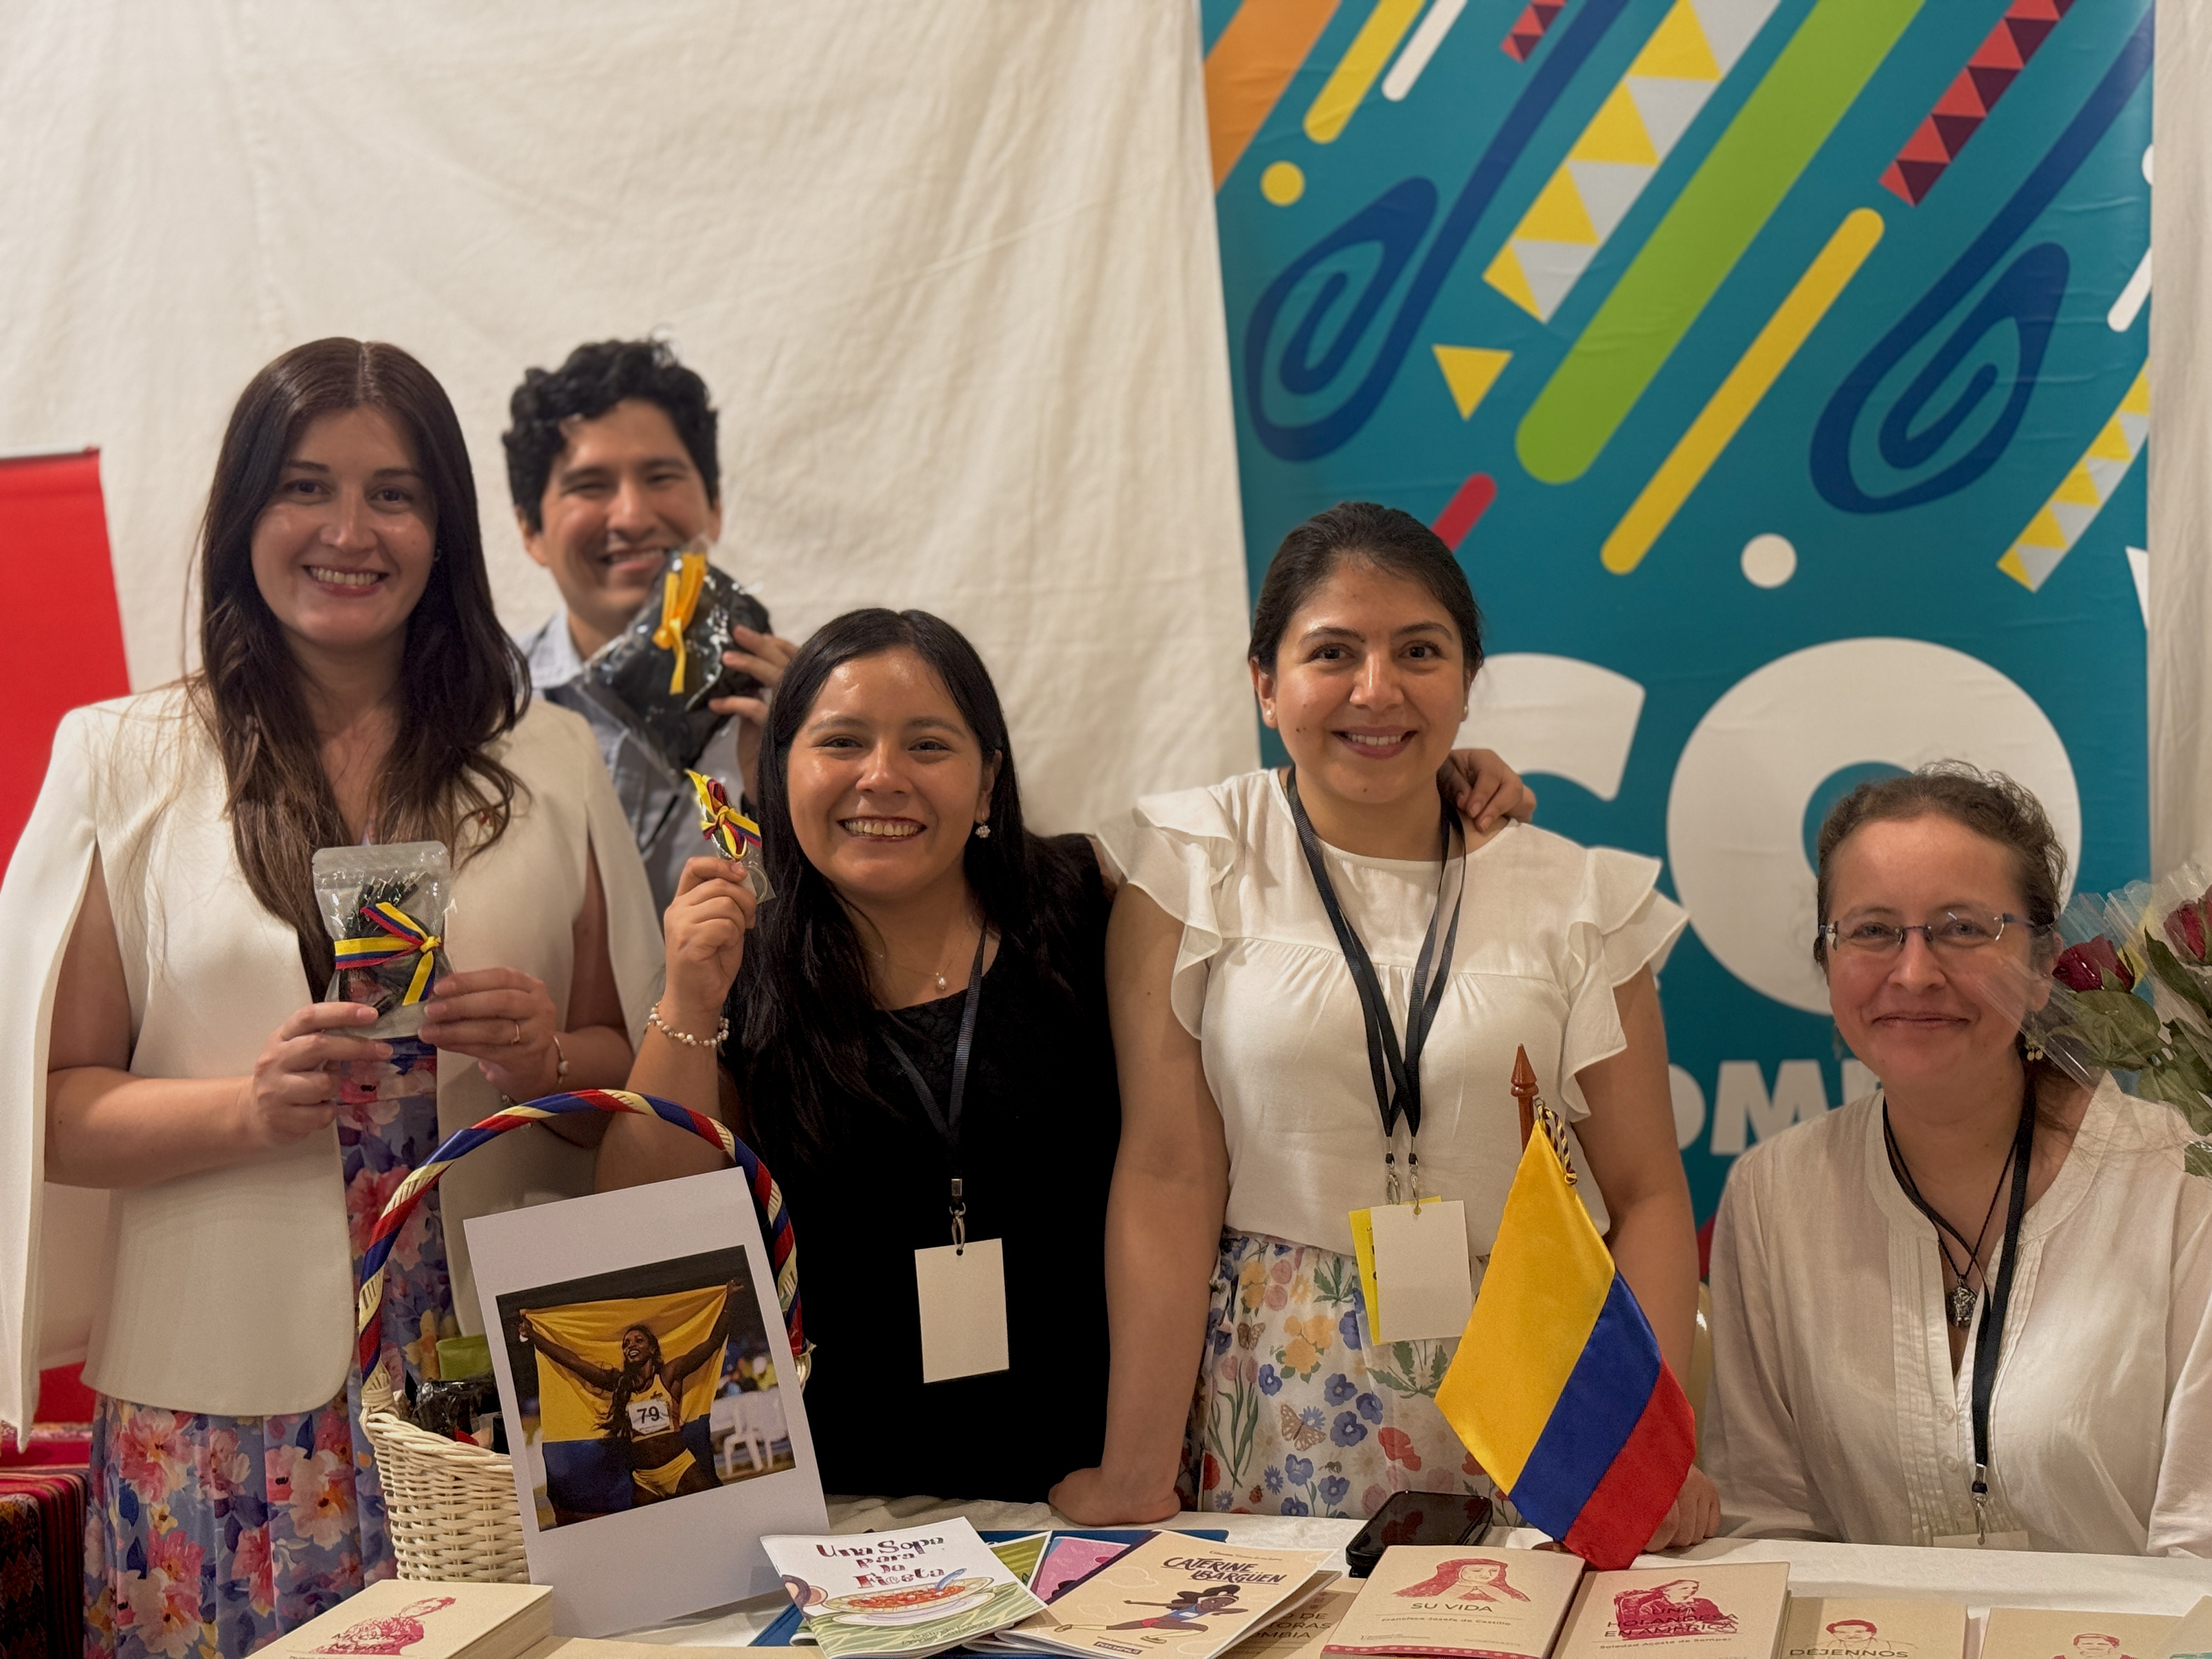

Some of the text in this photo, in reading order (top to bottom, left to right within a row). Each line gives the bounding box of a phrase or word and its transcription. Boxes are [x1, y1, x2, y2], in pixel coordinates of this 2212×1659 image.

[637, 1406, 659, 1424] 79
[816, 1536, 944, 1558] Una Sopa
[856, 1553, 916, 1568] para
[1163, 1557, 1259, 1572] CATERINE
[879, 1564, 906, 1574] la
[853, 1567, 945, 1589] Fiesta
[1444, 1604, 1493, 1612] VIDA
[1607, 1614, 1739, 1628] HOLANDESA
